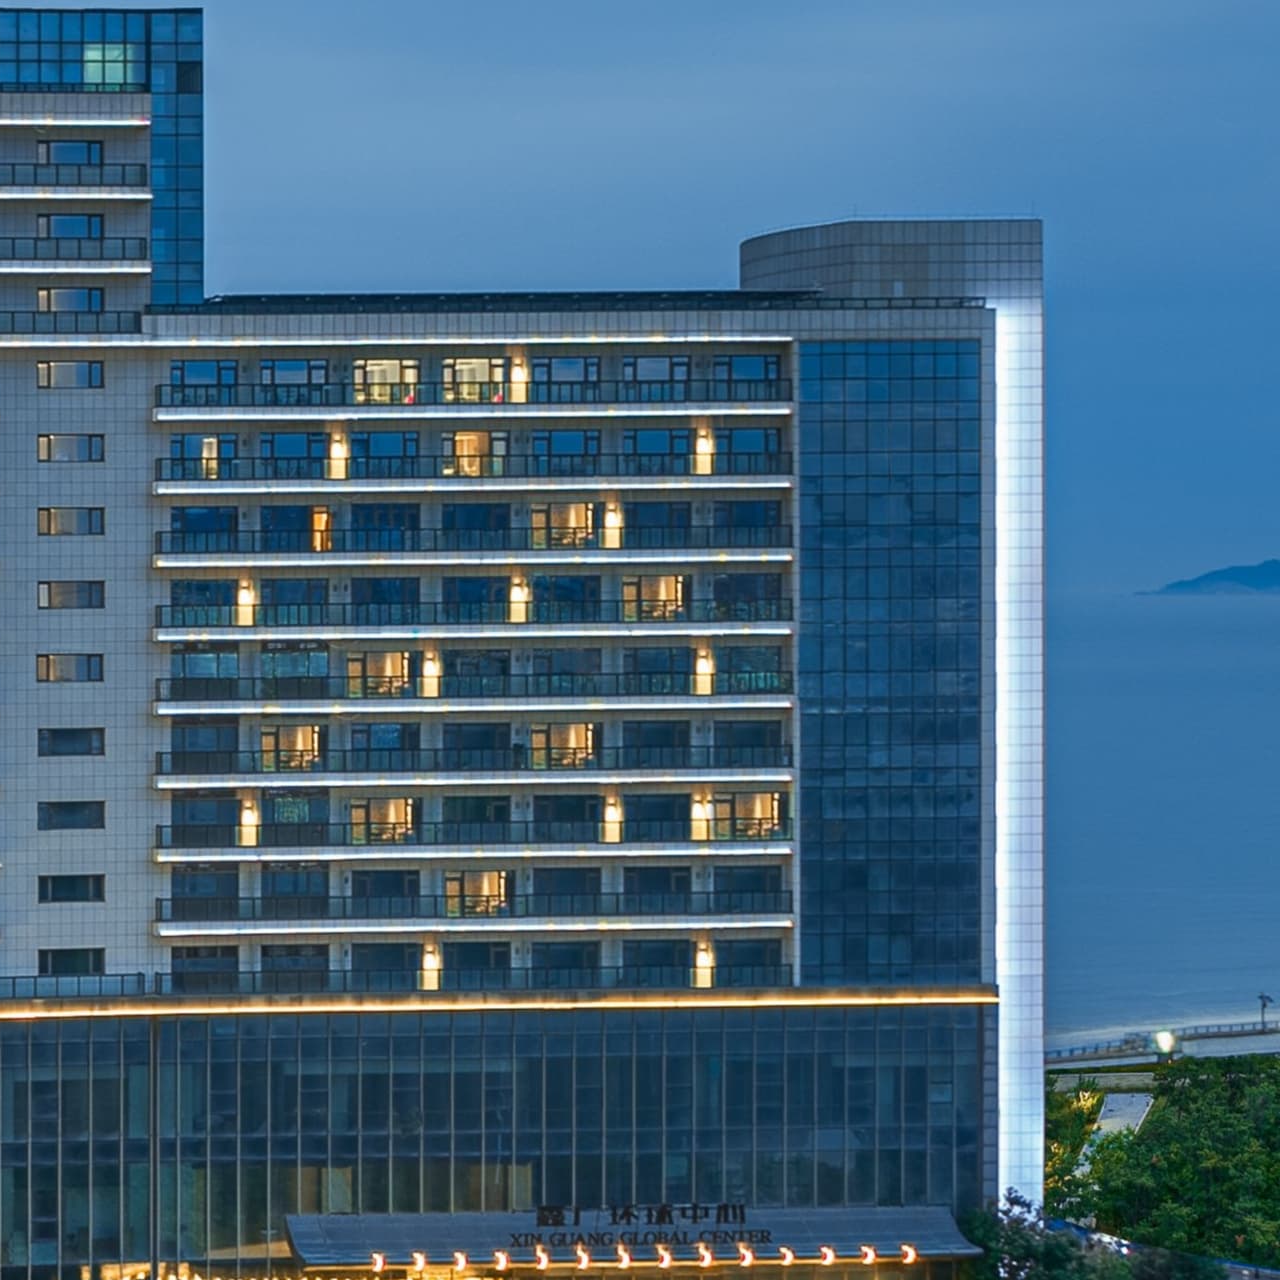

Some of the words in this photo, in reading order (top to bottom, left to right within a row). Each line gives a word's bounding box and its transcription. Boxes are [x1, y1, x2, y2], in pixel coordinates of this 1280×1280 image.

[510, 1233, 541, 1247] XIN
[549, 1231, 613, 1247] GUANG
[619, 1229, 690, 1246] GLOBAL
[698, 1229, 772, 1245] CENTER
